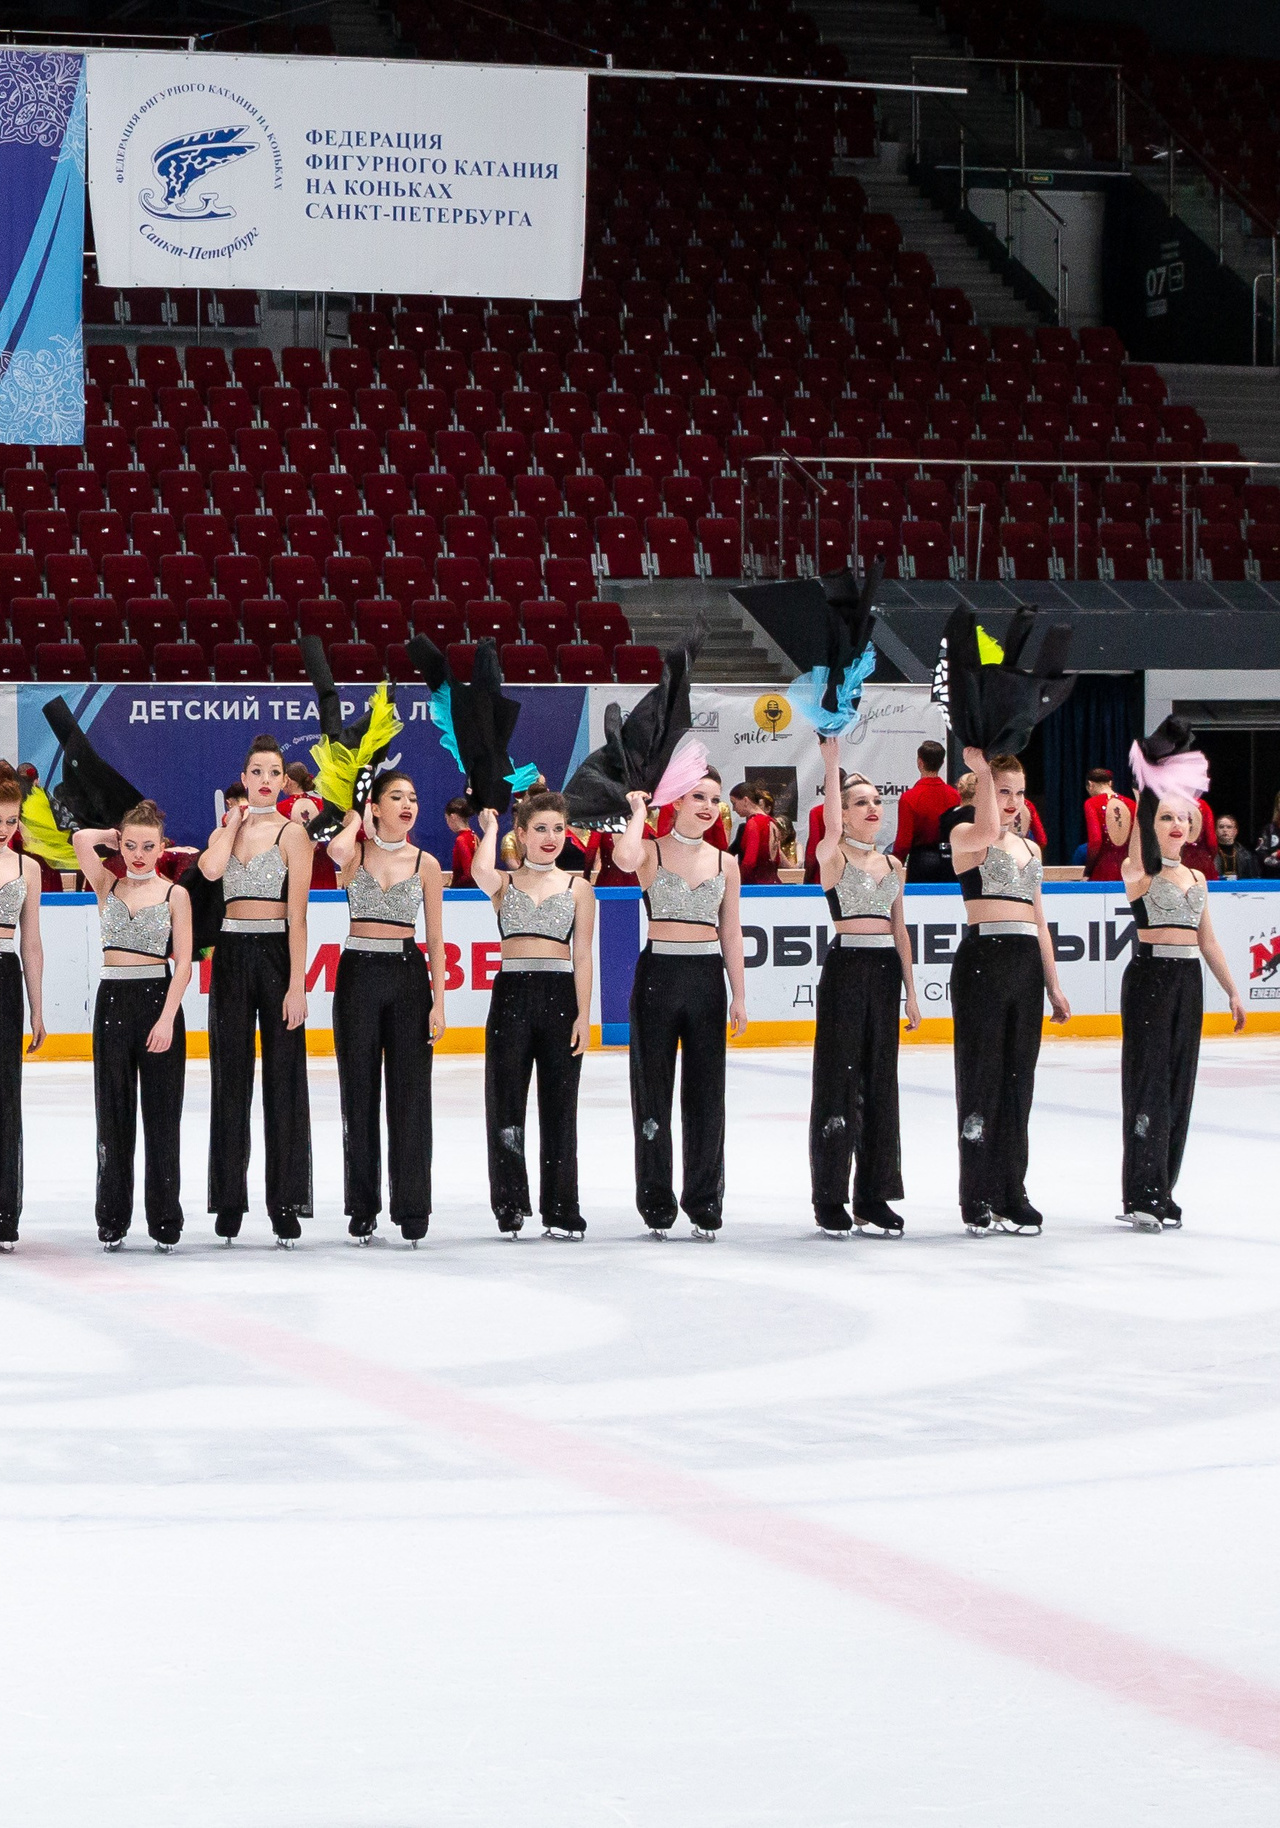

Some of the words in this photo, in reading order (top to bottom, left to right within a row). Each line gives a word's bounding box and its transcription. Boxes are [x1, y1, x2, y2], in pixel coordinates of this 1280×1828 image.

[116, 113, 141, 184] ФЕДЕРАЦИЯ
[139, 83, 205, 114] ФИГУРНОГО
[208, 84, 259, 117] КАТАНИЯ
[256, 115, 269, 132] НА
[267, 132, 283, 190] КОНЬКАХ
[305, 129, 442, 151] ФЕДЕРАЦИЯ
[305, 153, 447, 175] ФИГУРНОГО
[455, 159, 558, 180] КАТАНИЯ
[306, 178, 337, 195] НА
[345, 180, 453, 200] КОНЬКАХ
[305, 202, 532, 227] САНКТ-ПЕТЕРБУРГА
[139, 223, 260, 260] Санкт-Петербург
[129, 695, 260, 724] ДЕТСКИЙ
[269, 700, 355, 722] ТЕАР
[733, 727, 769, 745] smile
